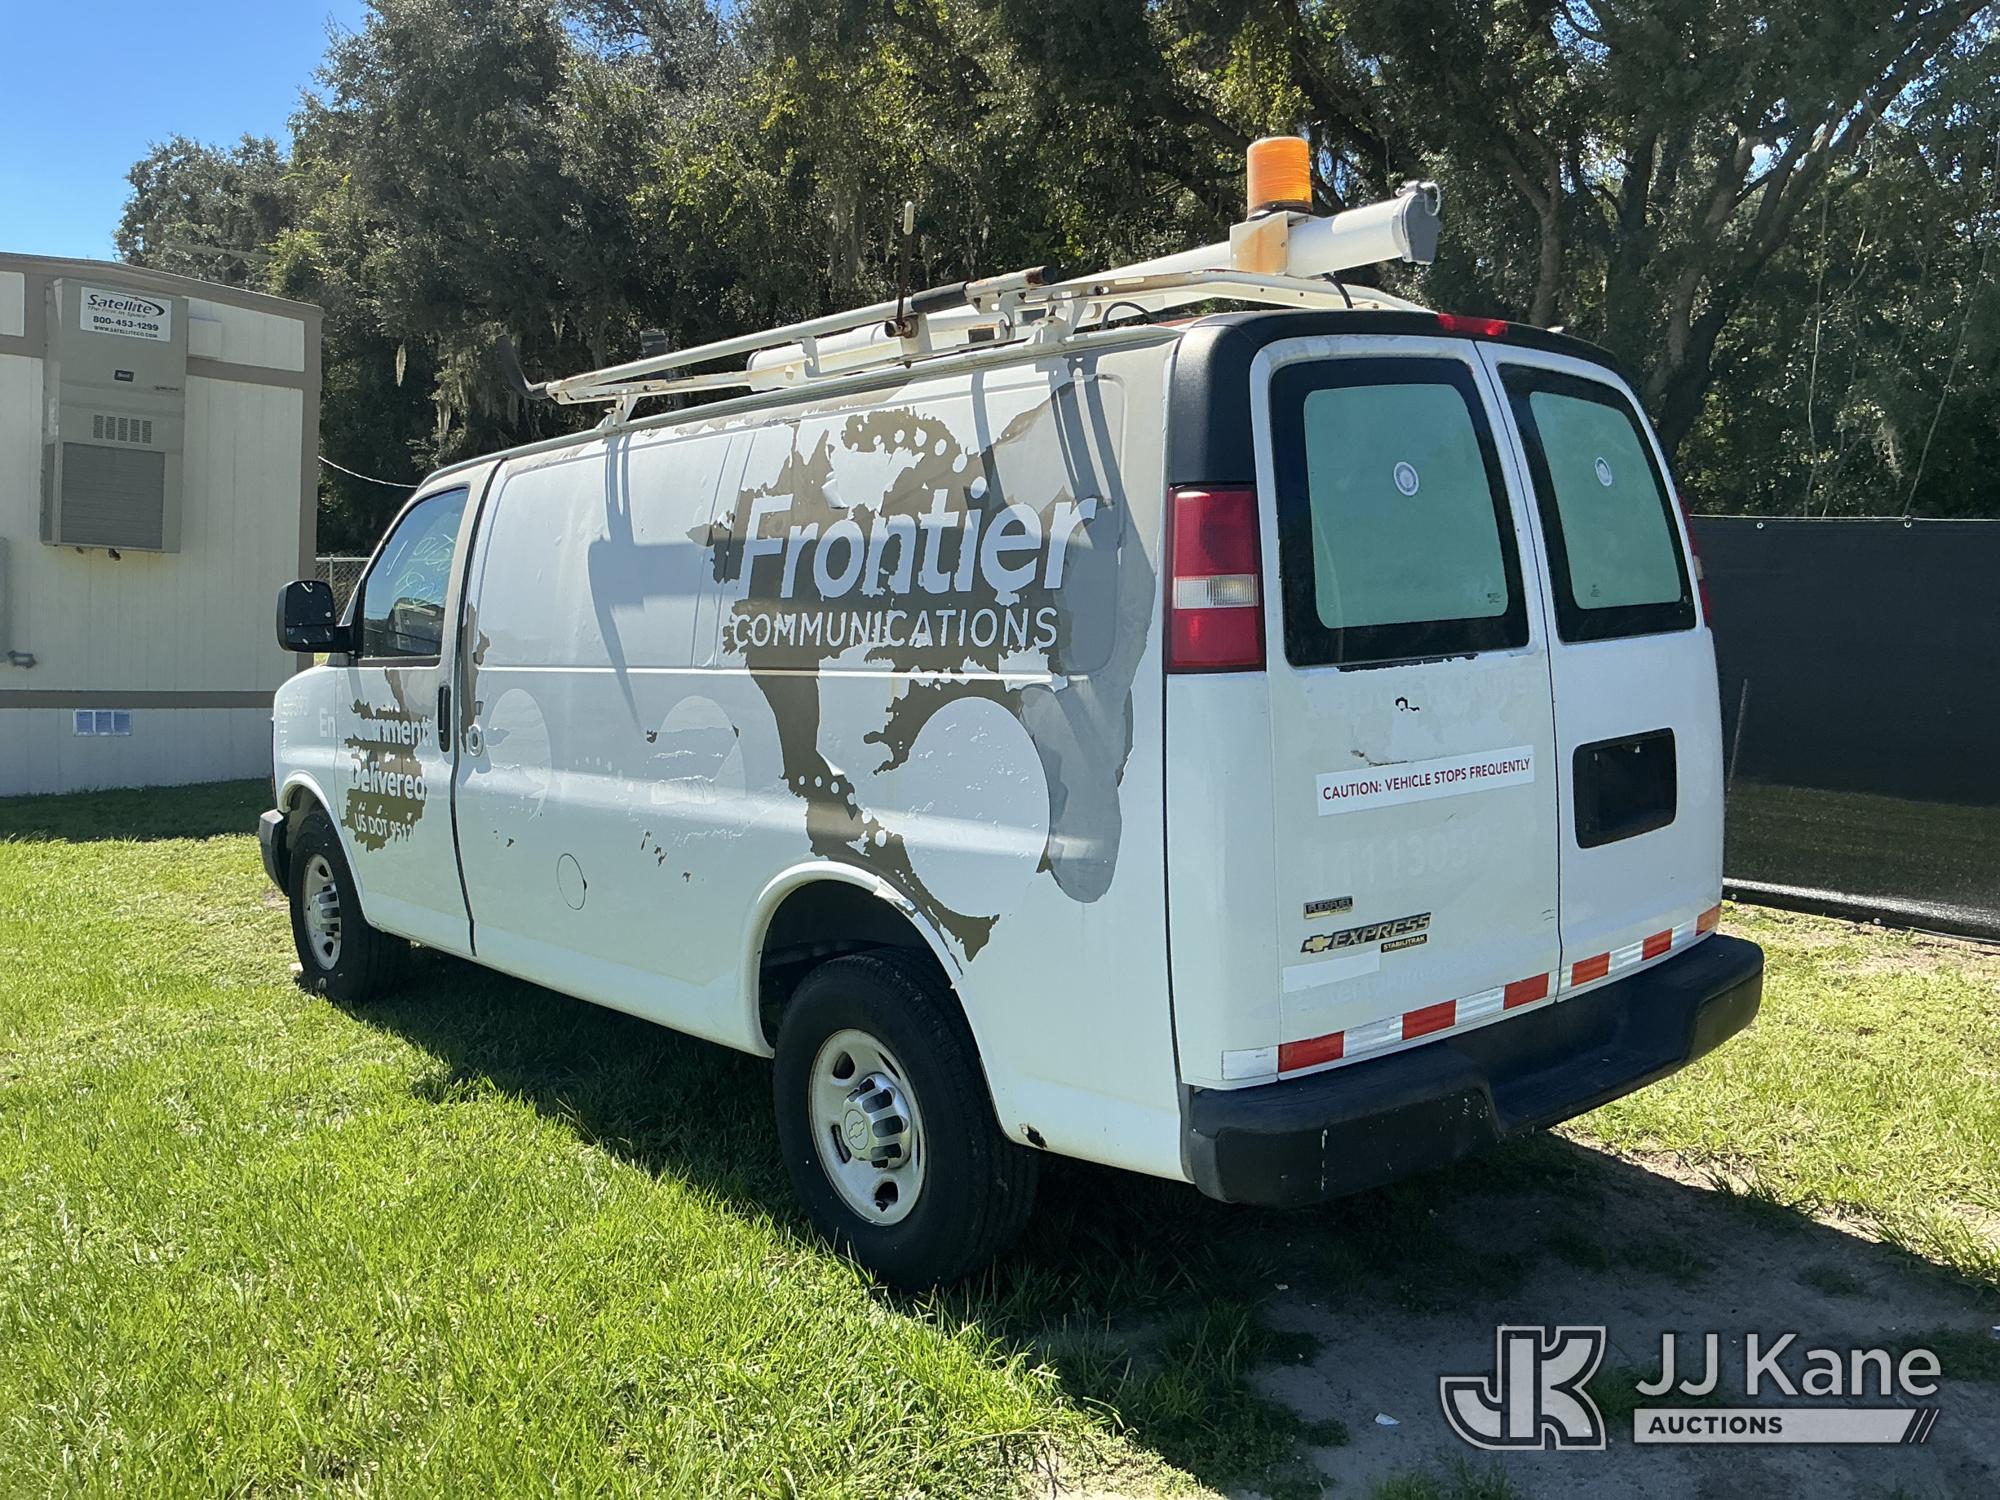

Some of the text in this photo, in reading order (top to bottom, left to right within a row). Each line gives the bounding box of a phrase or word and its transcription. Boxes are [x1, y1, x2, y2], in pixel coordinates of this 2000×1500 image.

[88, 294, 152, 314] Satellite
[93, 315, 159, 331] 800-453-1299
[739, 477, 1097, 602] Frontier
[733, 607, 1058, 648] COMMUNICATIONS
[1323, 757, 1531, 801] CAUTION: VEHICLE STOPS FREQUENTLY
[354, 813, 367, 833] US
[368, 816, 388, 838] DOT
[1331, 914, 1431, 949] EXPRESS
[1383, 935, 1426, 951] STABILITRAK
